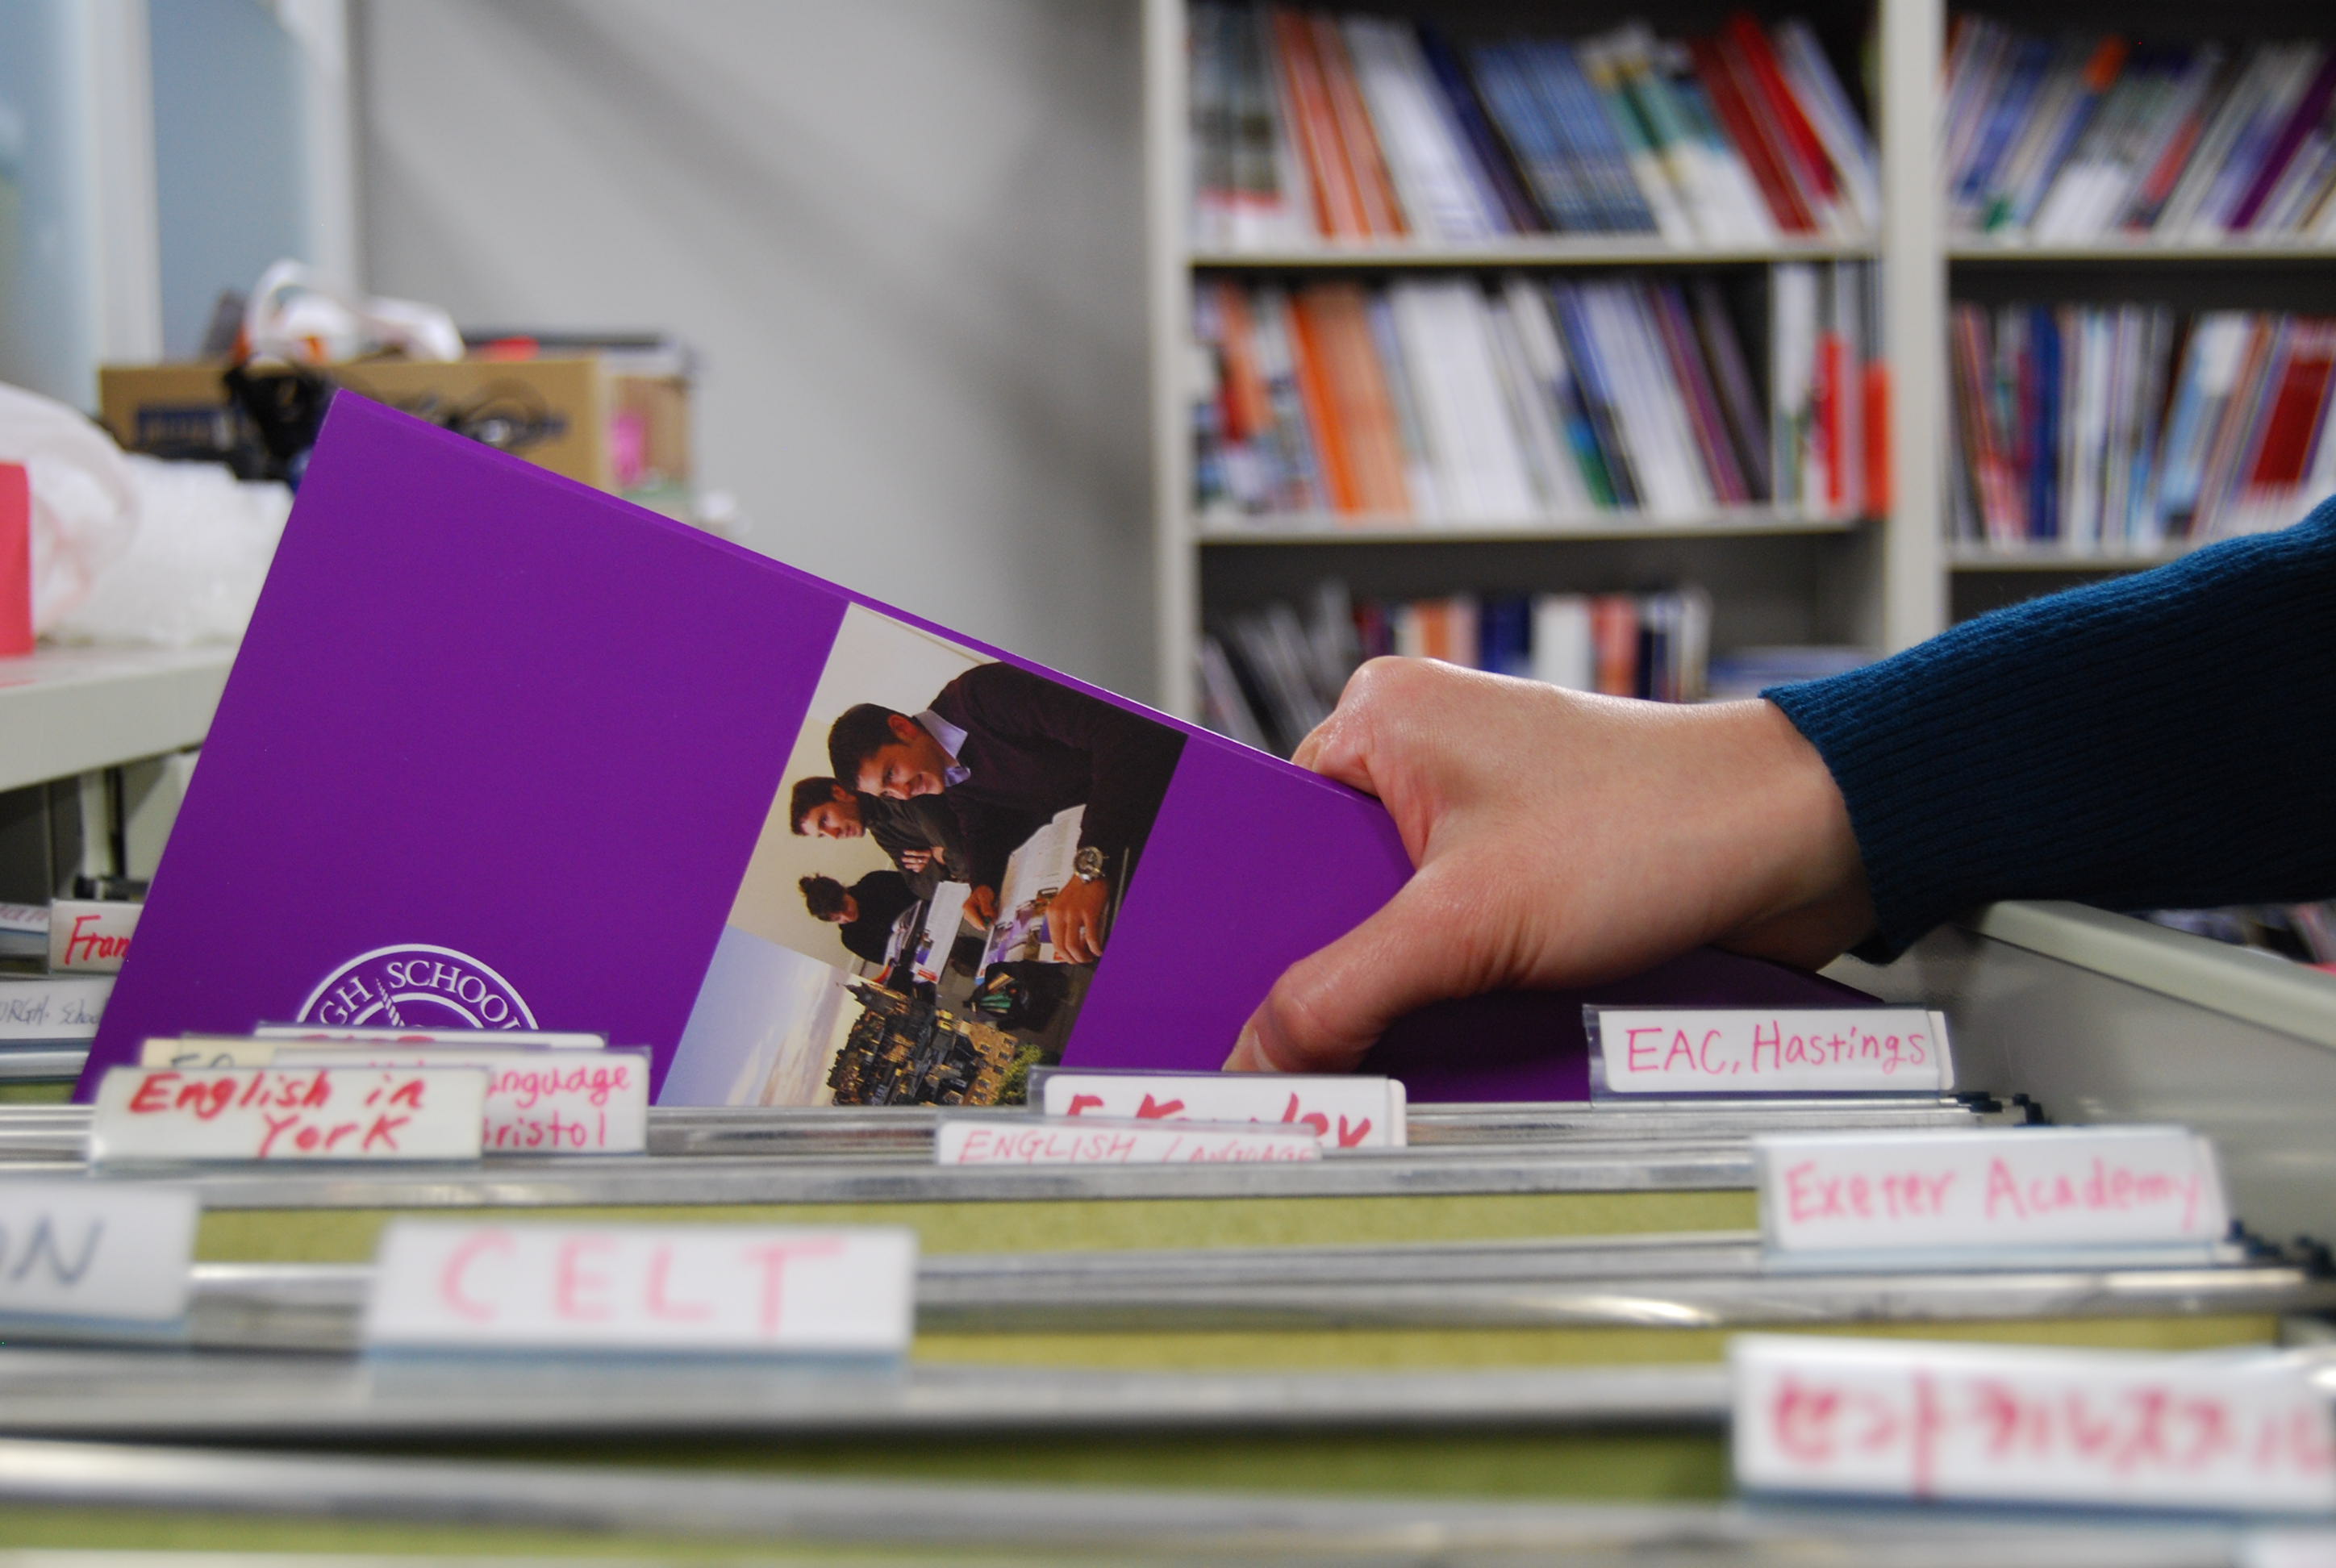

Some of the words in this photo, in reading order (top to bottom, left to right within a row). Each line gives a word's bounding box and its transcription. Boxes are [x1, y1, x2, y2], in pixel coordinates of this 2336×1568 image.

[128, 1068, 332, 1121] English
[365, 1070, 425, 1110] in
[957, 1128, 1137, 1165] ENGLISH
[1783, 1160, 1959, 1224] Exeter
[1983, 1155, 2202, 1232] Academy
[434, 1225, 848, 1339] CELT
